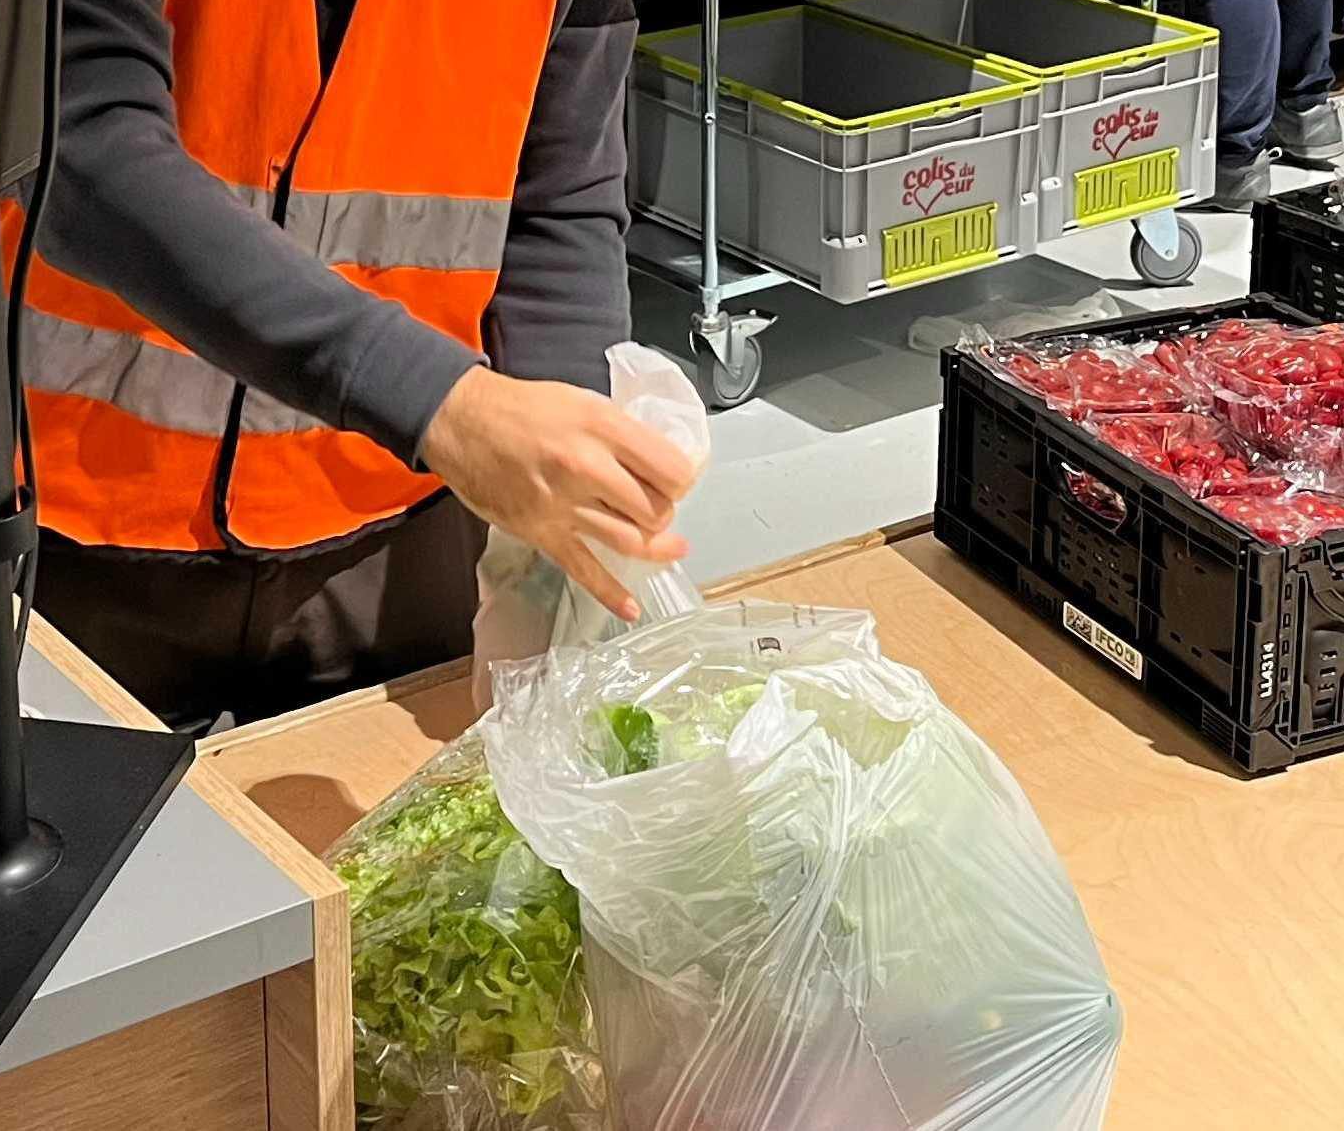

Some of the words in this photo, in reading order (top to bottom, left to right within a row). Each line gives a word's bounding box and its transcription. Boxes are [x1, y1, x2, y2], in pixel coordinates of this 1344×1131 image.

[1093, 103, 1141, 136] colis
[1144, 109, 1159, 123] du
[903, 156, 956, 190] colis
[959, 162, 976, 178] du
[1095, 626, 1124, 658] IFCO
[1260, 643, 1275, 698] LL4314
